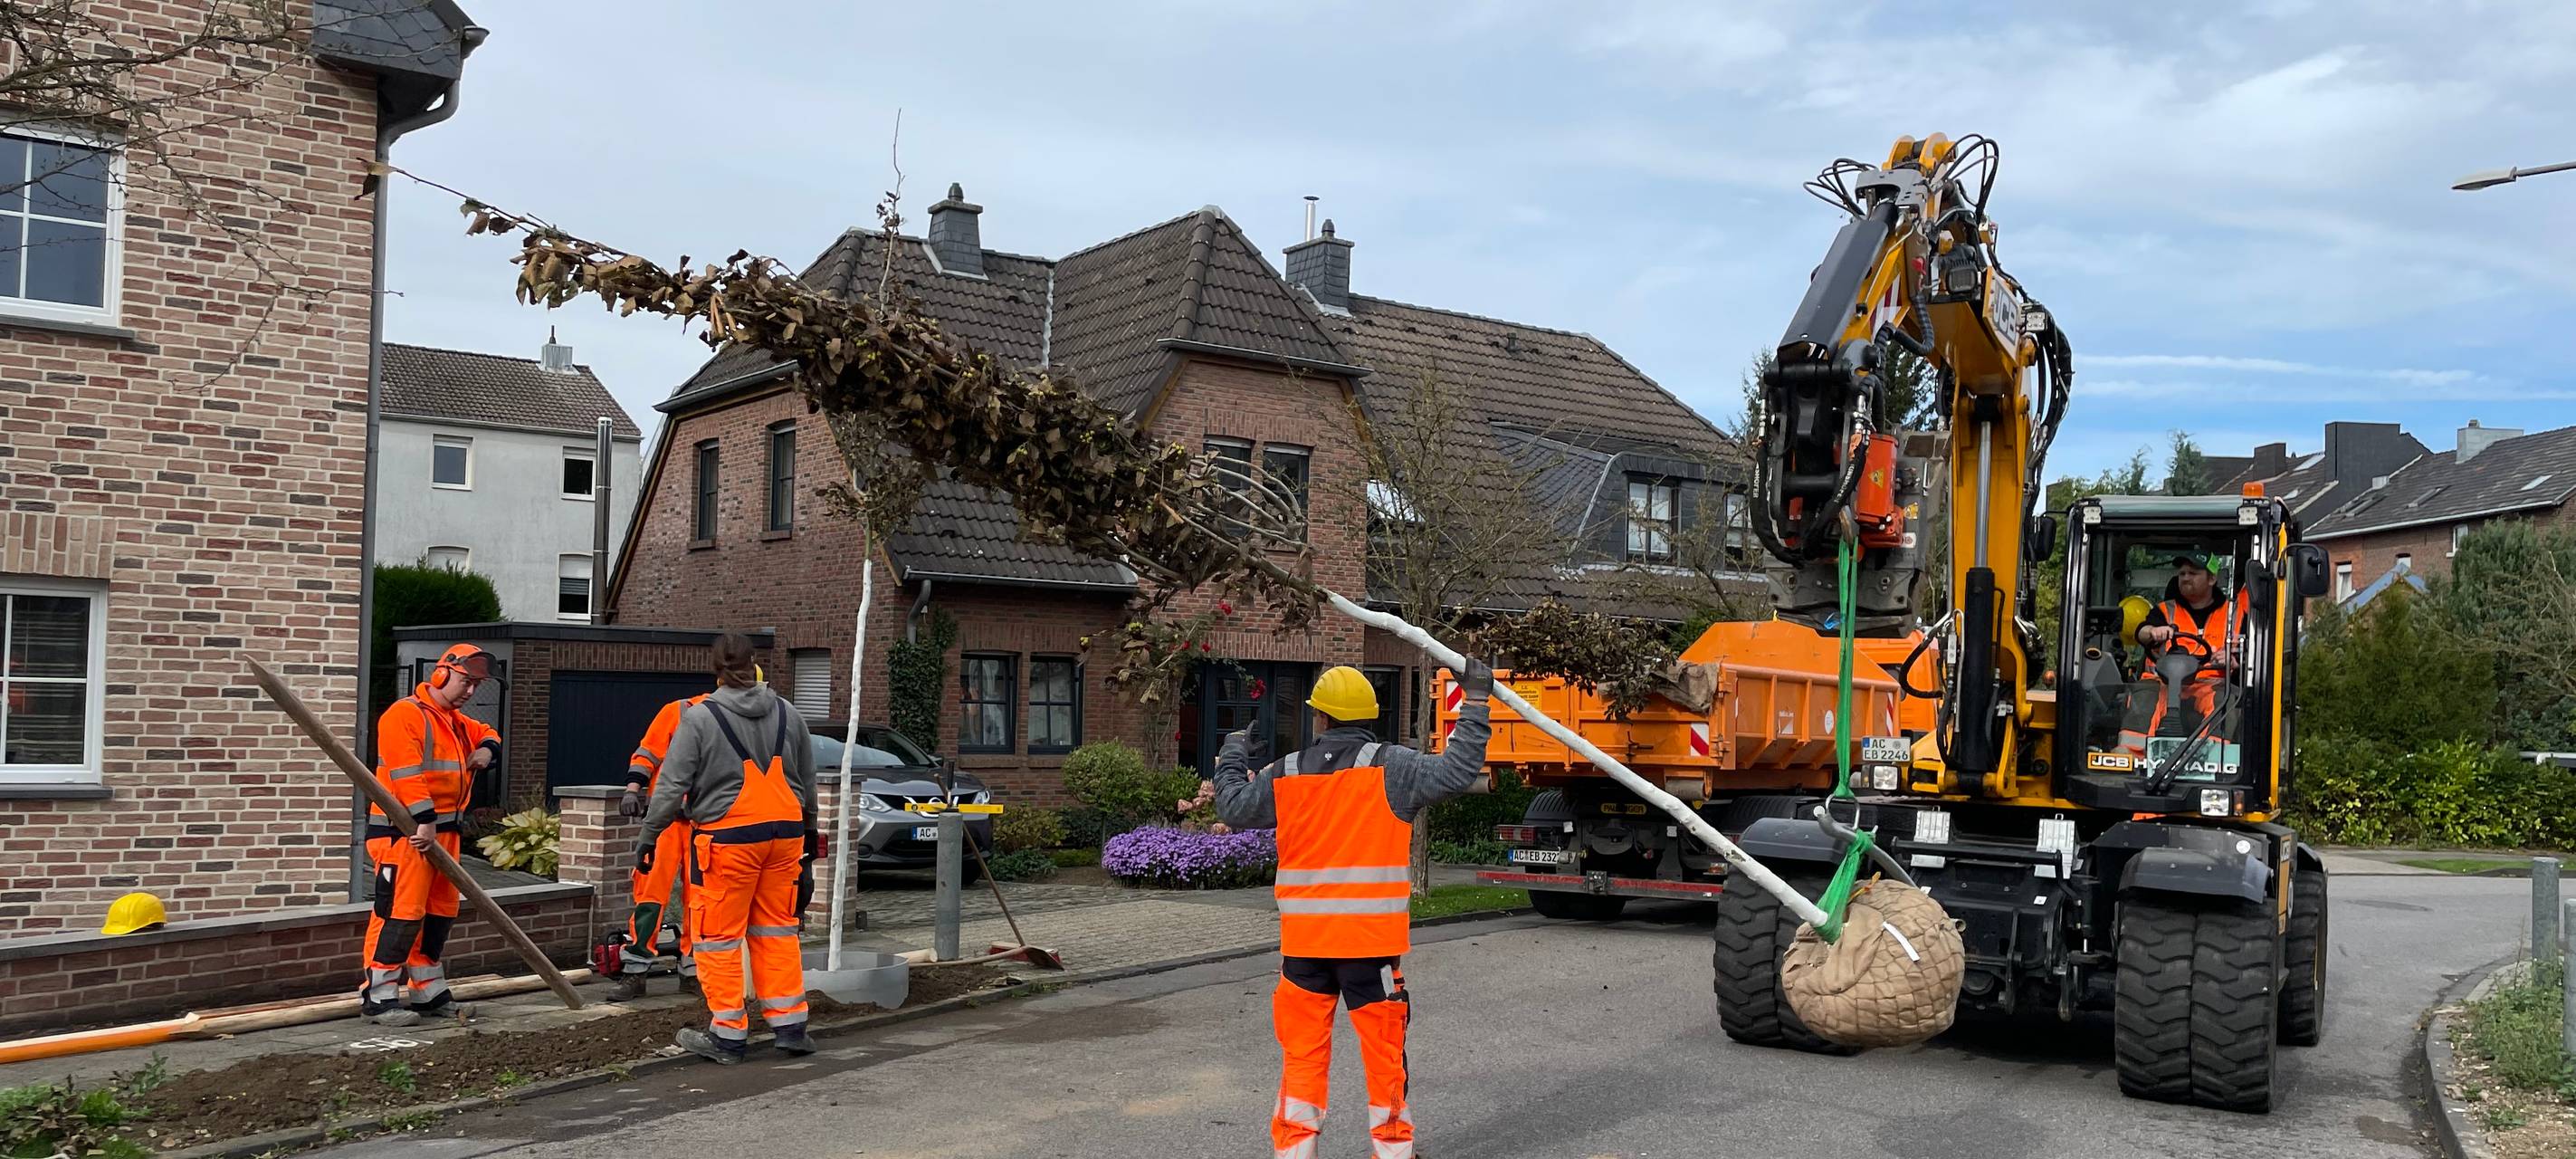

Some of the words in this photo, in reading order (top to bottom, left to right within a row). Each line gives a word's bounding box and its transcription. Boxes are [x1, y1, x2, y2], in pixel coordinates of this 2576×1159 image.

[1993, 287, 2018, 343] JCB
[1872, 739, 1885, 748] AC
[1865, 750, 1878, 760] EB
[1881, 750, 1908, 761] 2246
[2092, 755, 2130, 767] JCB
[2134, 757, 2237, 774] HYADIG
[920, 829, 930, 838] AC
[1514, 850, 1524, 860] AC
[1530, 851, 1540, 861] EB
[1541, 852, 1559, 862] 232
